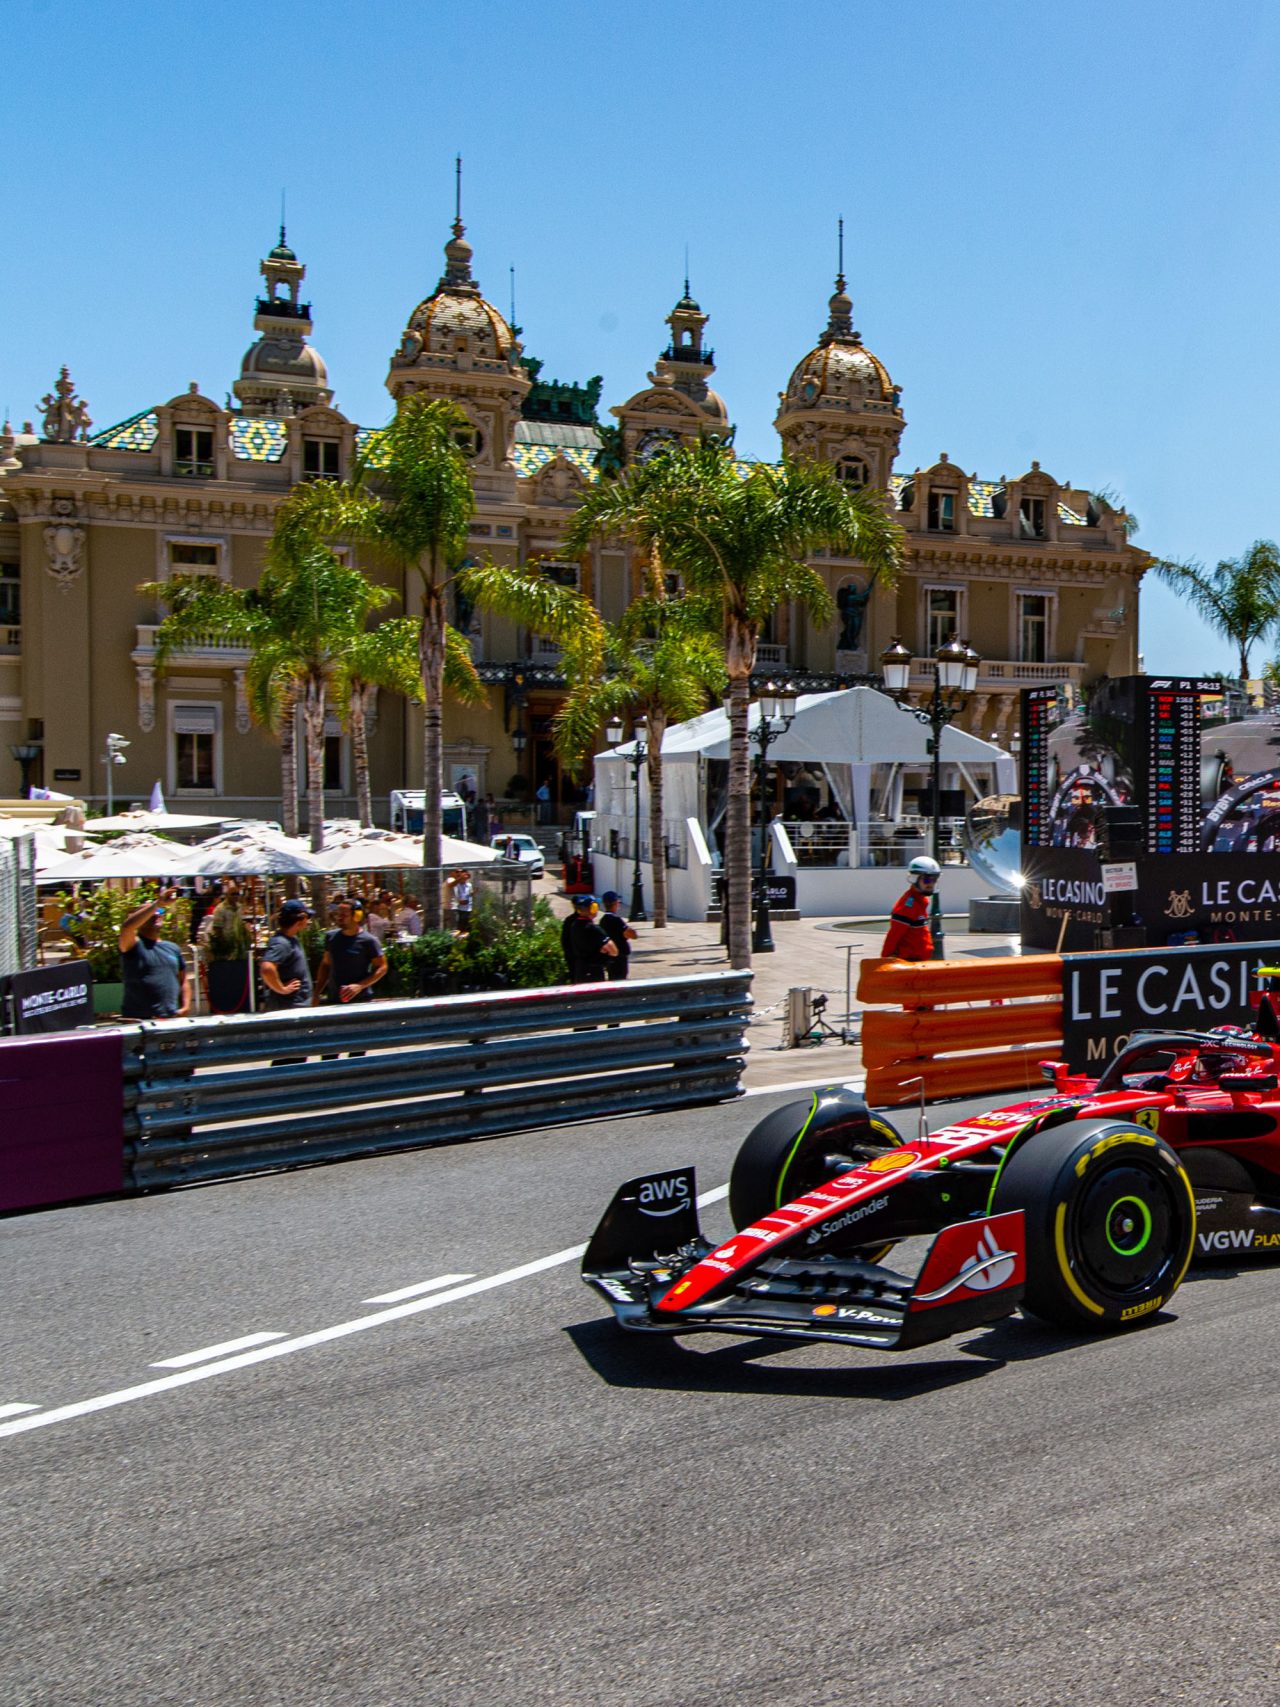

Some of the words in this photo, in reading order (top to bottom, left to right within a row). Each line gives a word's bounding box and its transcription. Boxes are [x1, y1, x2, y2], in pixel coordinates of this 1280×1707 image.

[1238, 773, 1273, 791] ORACLE
[1206, 793, 1234, 823] BYBIT
[1043, 879, 1056, 900] LE
[1057, 881, 1104, 905] CASINO
[1202, 881, 1230, 905] LE
[1072, 969, 1122, 1021] LE
[1221, 1042, 1258, 1050] TECHNOLOGY
[976, 1112, 1035, 1123] VGW
[915, 1126, 998, 1146] 55
[1075, 1153, 1091, 1178] P
[1091, 1132, 1157, 1158] ZERO
[640, 1177, 689, 1203] aws
[837, 1177, 867, 1188] aws
[821, 1196, 890, 1237] Santander
[1198, 1229, 1255, 1252] VGW
[838, 1308, 903, 1325] V-Pow
